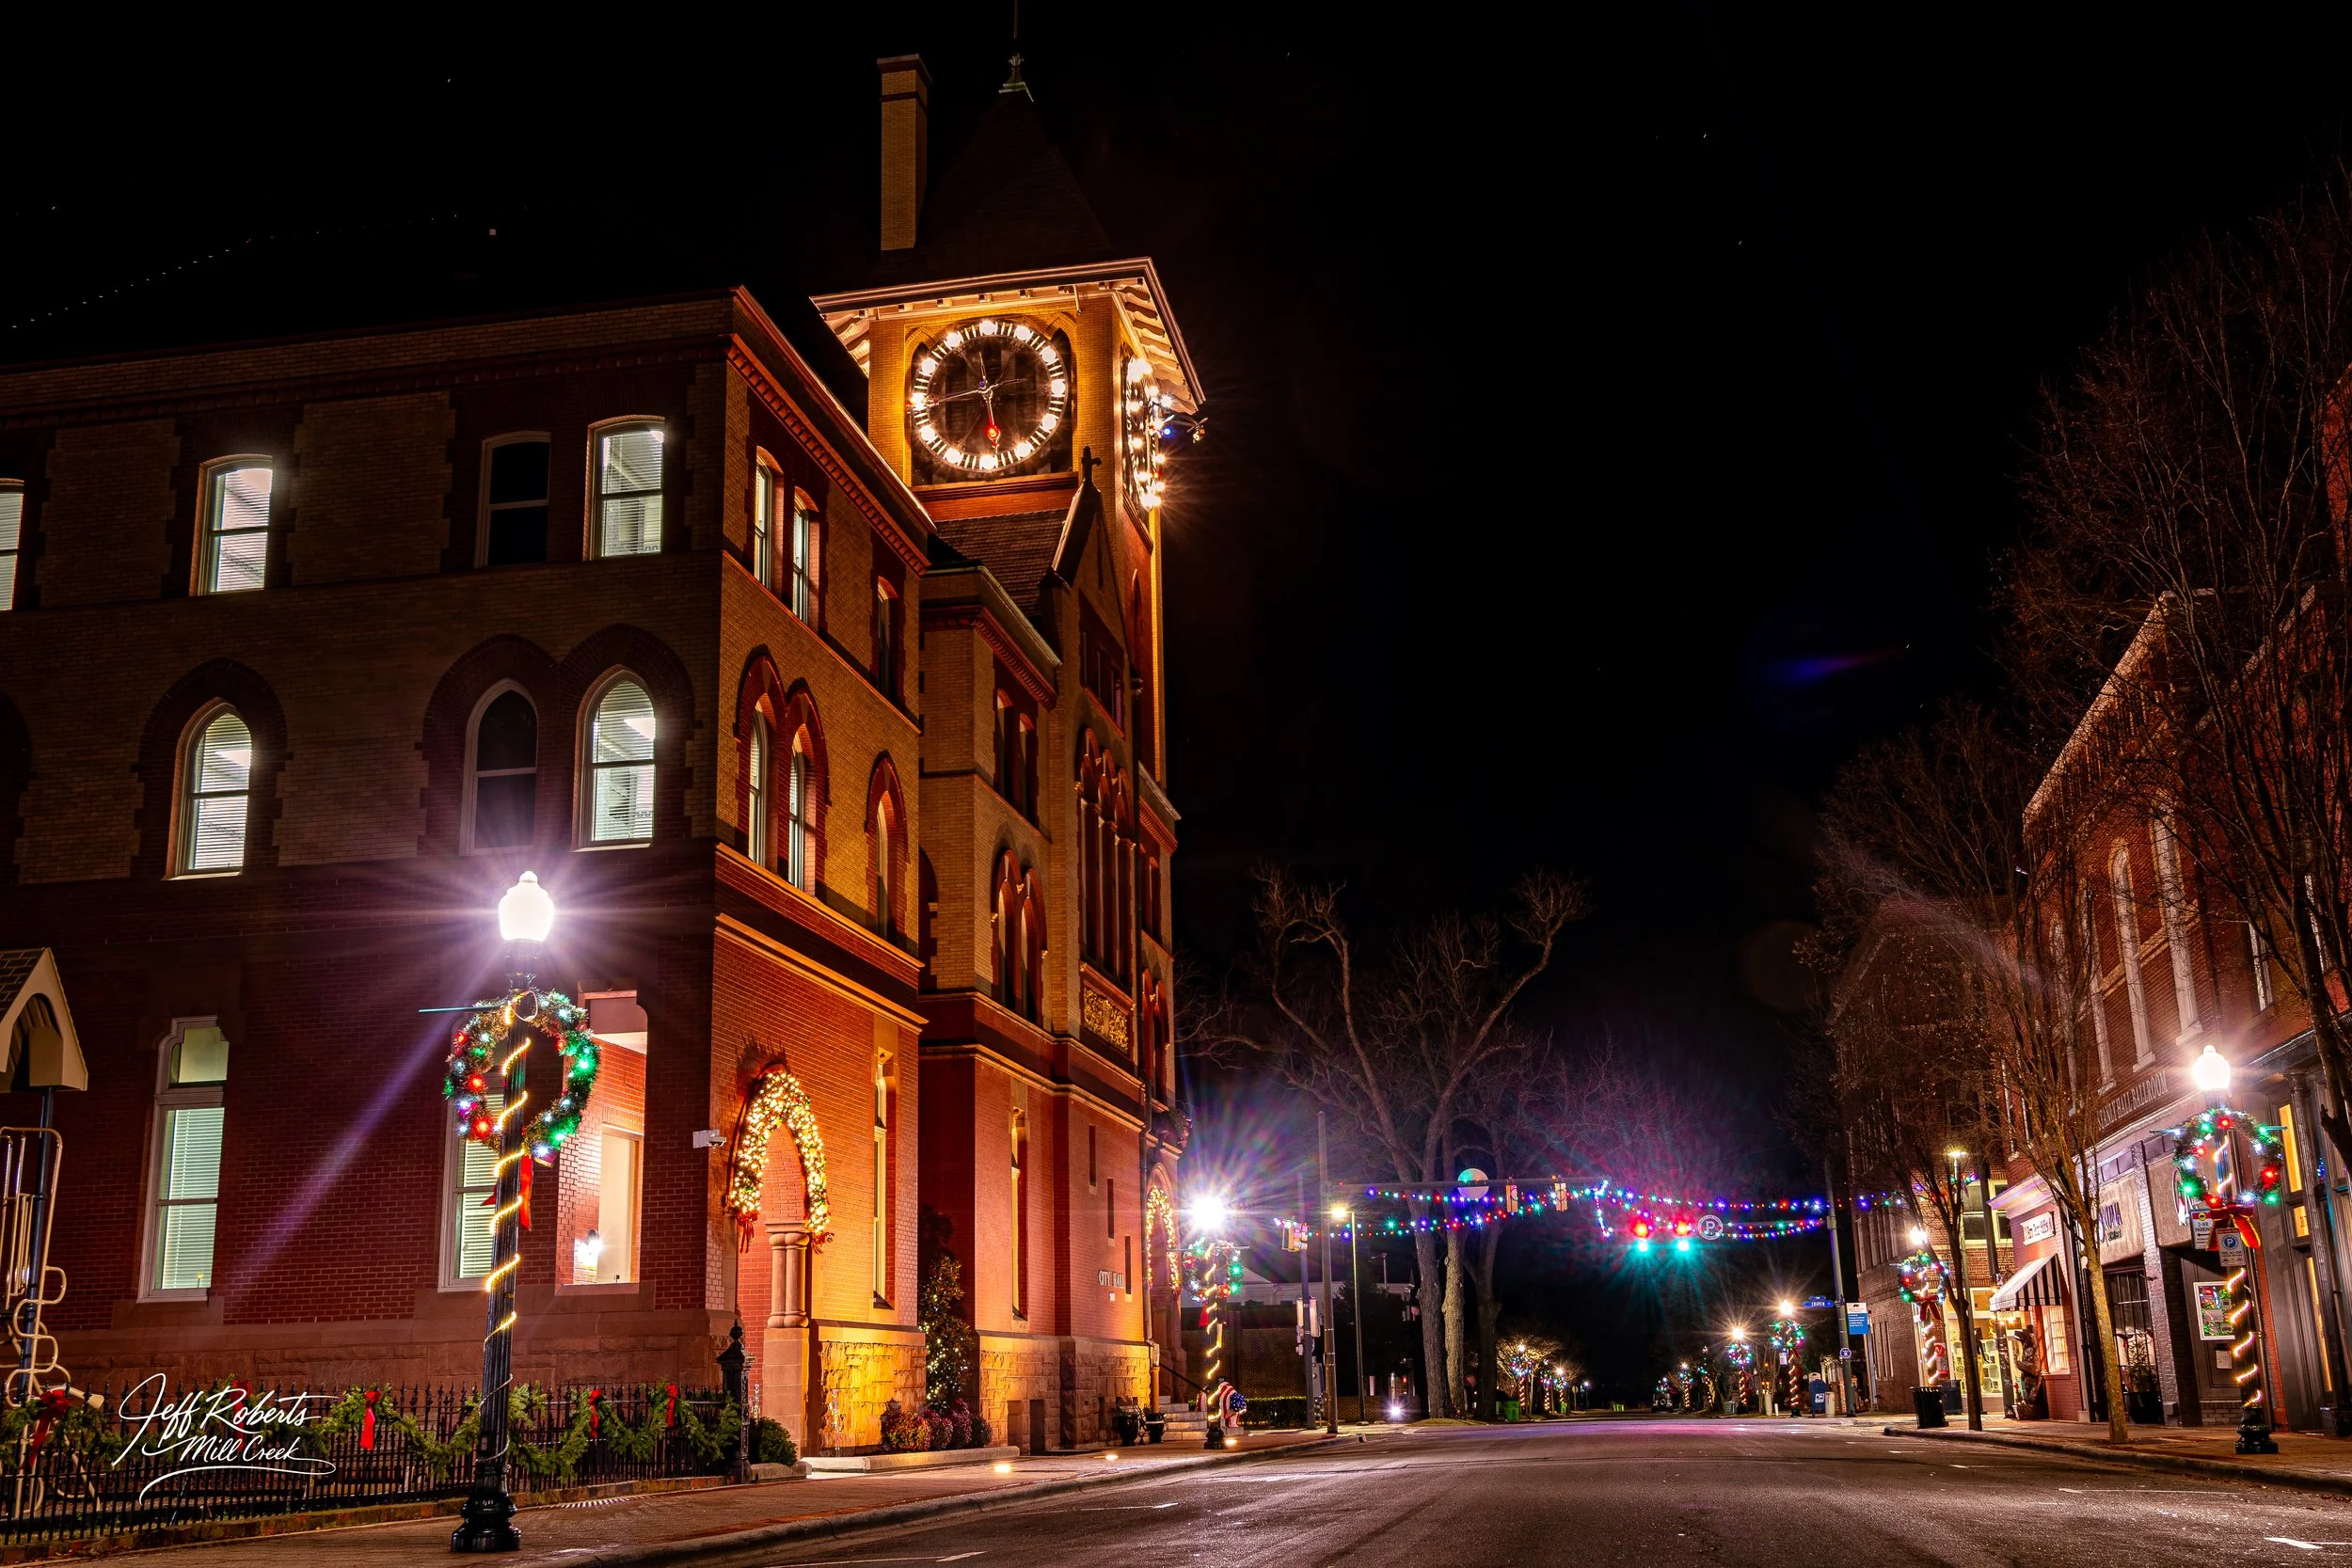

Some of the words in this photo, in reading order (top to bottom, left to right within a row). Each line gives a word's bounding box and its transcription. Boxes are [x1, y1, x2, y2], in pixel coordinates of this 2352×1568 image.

[2131, 1070, 2168, 1111] BALLROOM
[1098, 1270, 1110, 1286] CITY
[1112, 1271, 1125, 1289] HALL
